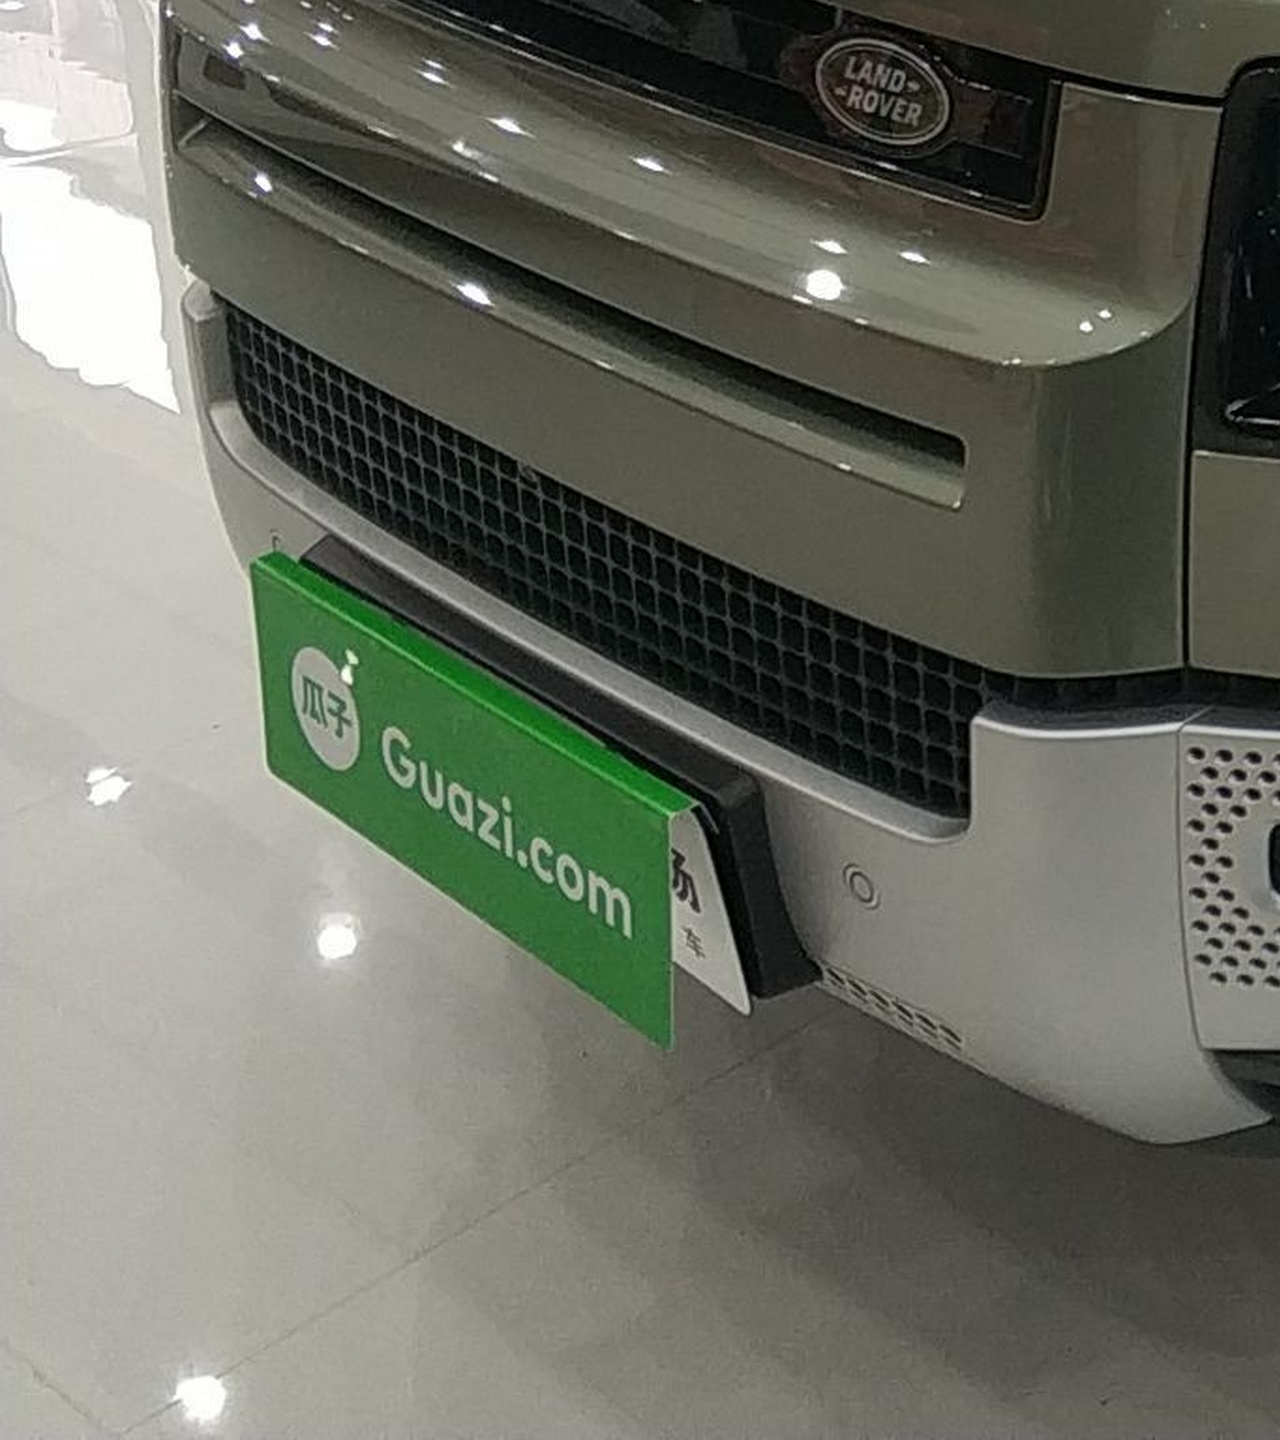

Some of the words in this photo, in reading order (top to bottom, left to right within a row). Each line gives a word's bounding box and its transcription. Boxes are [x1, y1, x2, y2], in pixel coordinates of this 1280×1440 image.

[844, 56, 906, 93] LAND
[846, 84, 922, 127] ROVER
[301, 675, 352, 739] 瓜子
[381, 726, 633, 940] Guazi.com
